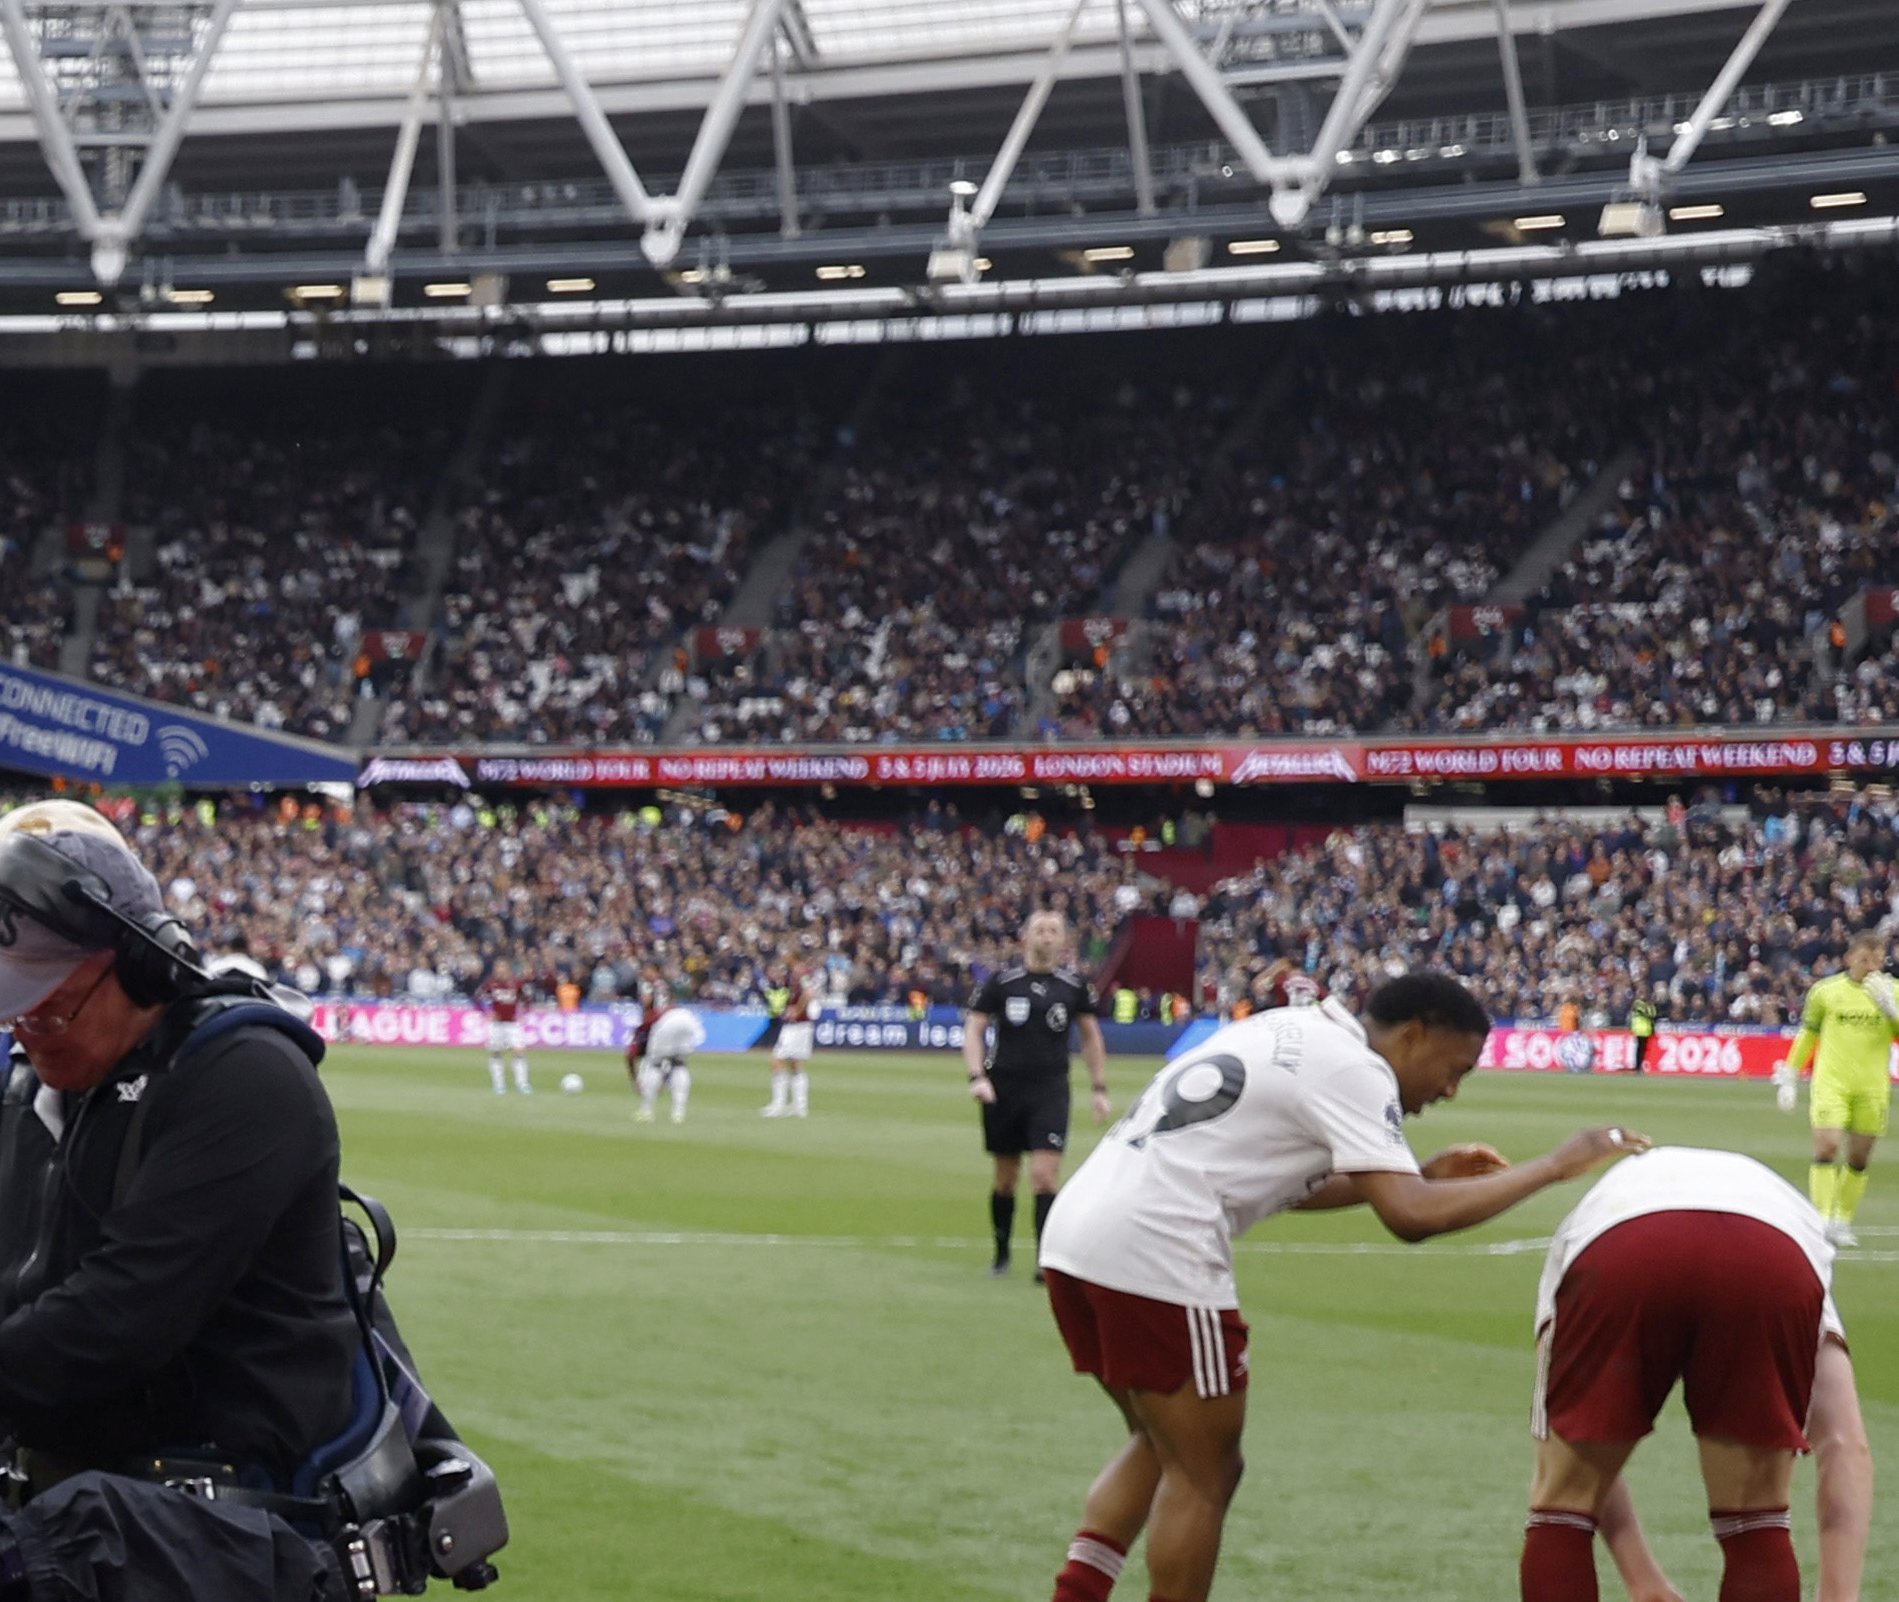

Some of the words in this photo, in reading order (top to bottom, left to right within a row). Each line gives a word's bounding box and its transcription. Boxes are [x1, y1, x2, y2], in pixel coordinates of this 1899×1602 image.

[1034, 754, 1126, 778] LONDON
[1127, 753, 1223, 777] STADIUM
[1415, 749, 1499, 773] WORLD
[1502, 748, 1563, 772] TOUR
[1574, 746, 1613, 770] NO
[1614, 745, 1700, 769] REPEAT
[1701, 742, 1817, 768] WEEKEND
[457, 1008, 614, 1047] SCCER
[816, 1019, 907, 1047] dream
[1658, 1035, 1743, 1074] 2026
